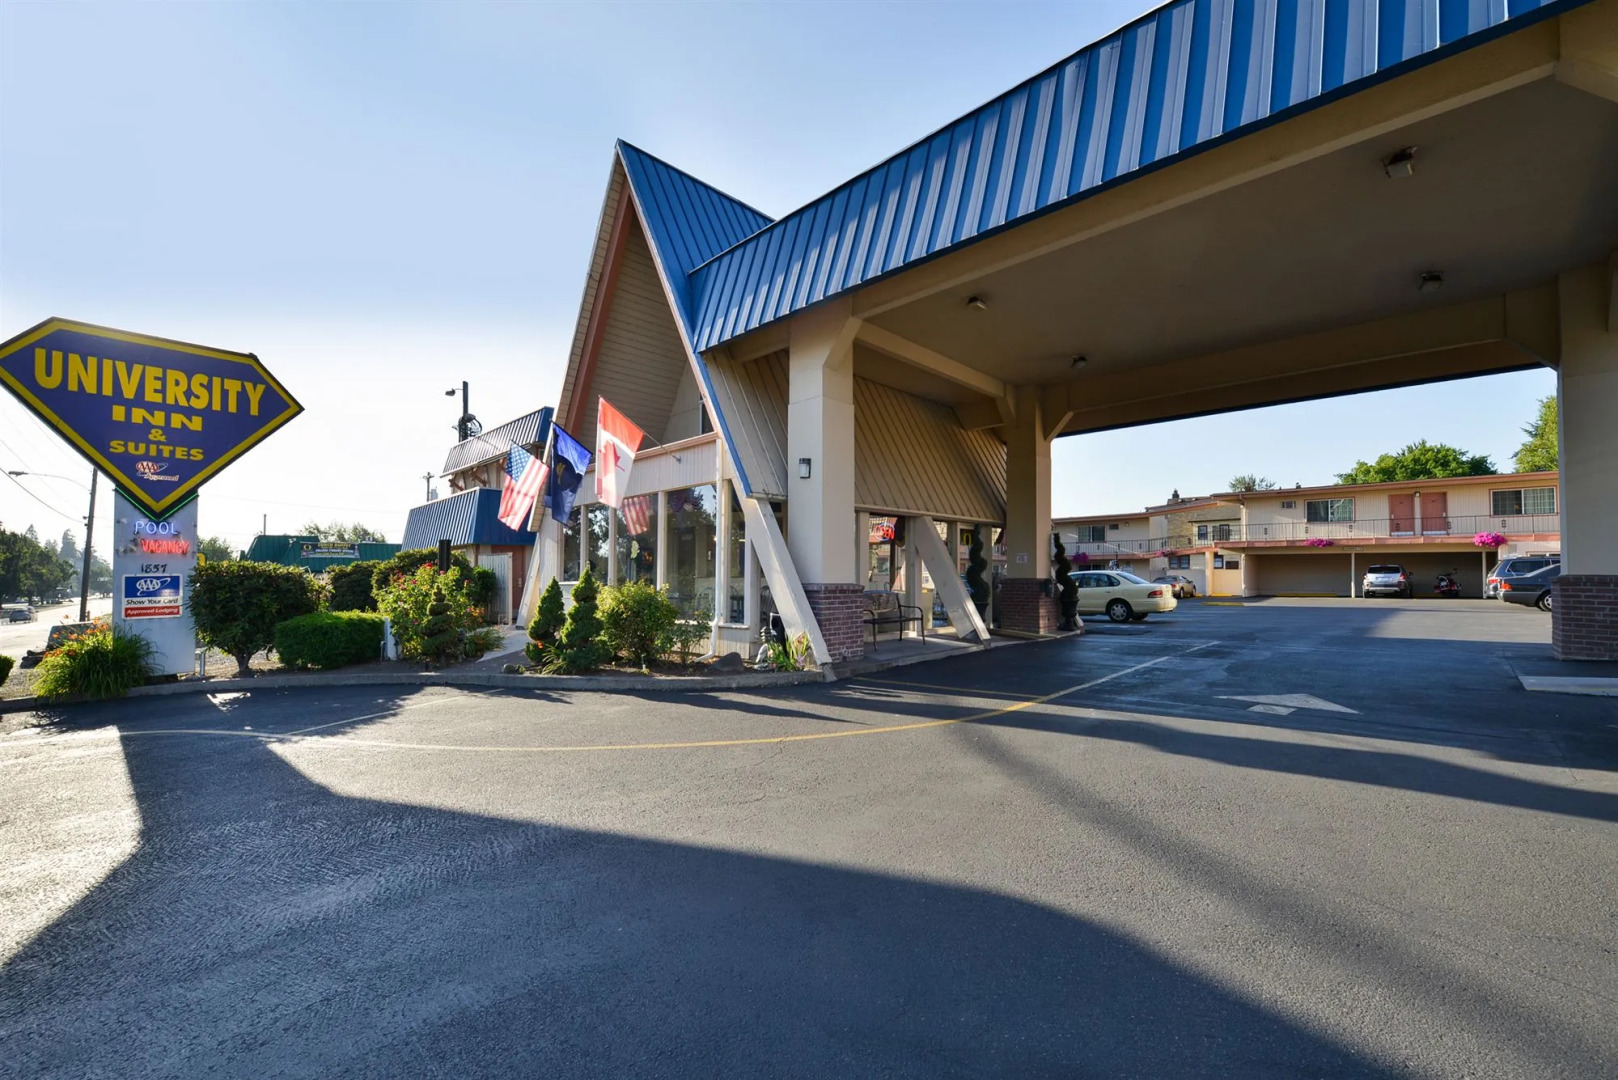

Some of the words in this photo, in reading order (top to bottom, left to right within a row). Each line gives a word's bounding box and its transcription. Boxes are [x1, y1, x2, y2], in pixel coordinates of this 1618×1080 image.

[34, 347, 266, 416] UNIVERSITY
[111, 404, 203, 432] INN
[148, 428, 167, 442] &
[109, 440, 204, 461] SUITES
[138, 461, 158, 472] AAA
[134, 521, 178, 535] POOL
[874, 524, 895, 540] OPEN
[141, 539, 189, 554] VACANCY
[141, 563, 168, 573] 1857
[137, 578, 160, 590] AAA
